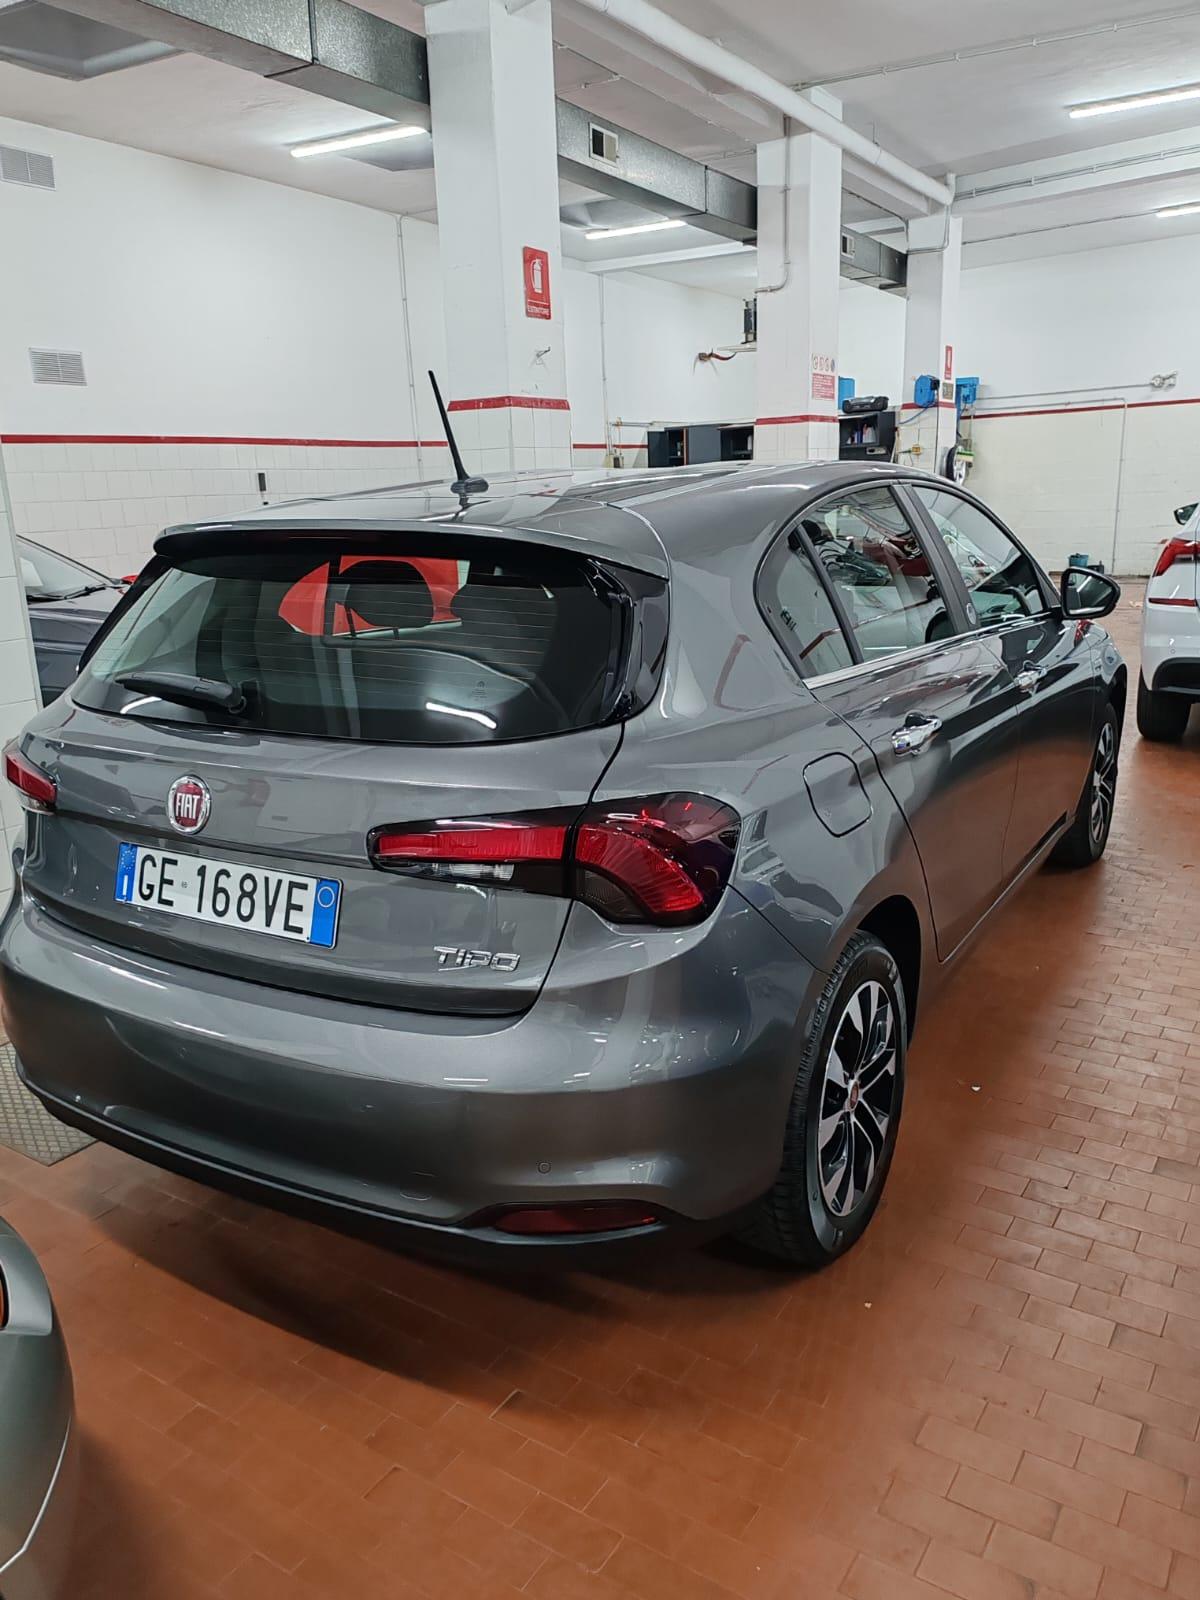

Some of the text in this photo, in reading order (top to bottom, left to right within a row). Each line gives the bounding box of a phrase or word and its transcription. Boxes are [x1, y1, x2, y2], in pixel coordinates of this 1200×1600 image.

[176, 793, 201, 819] FIAT
[138, 854, 309, 934] GE 168VE
[433, 946, 520, 972] TIPO
